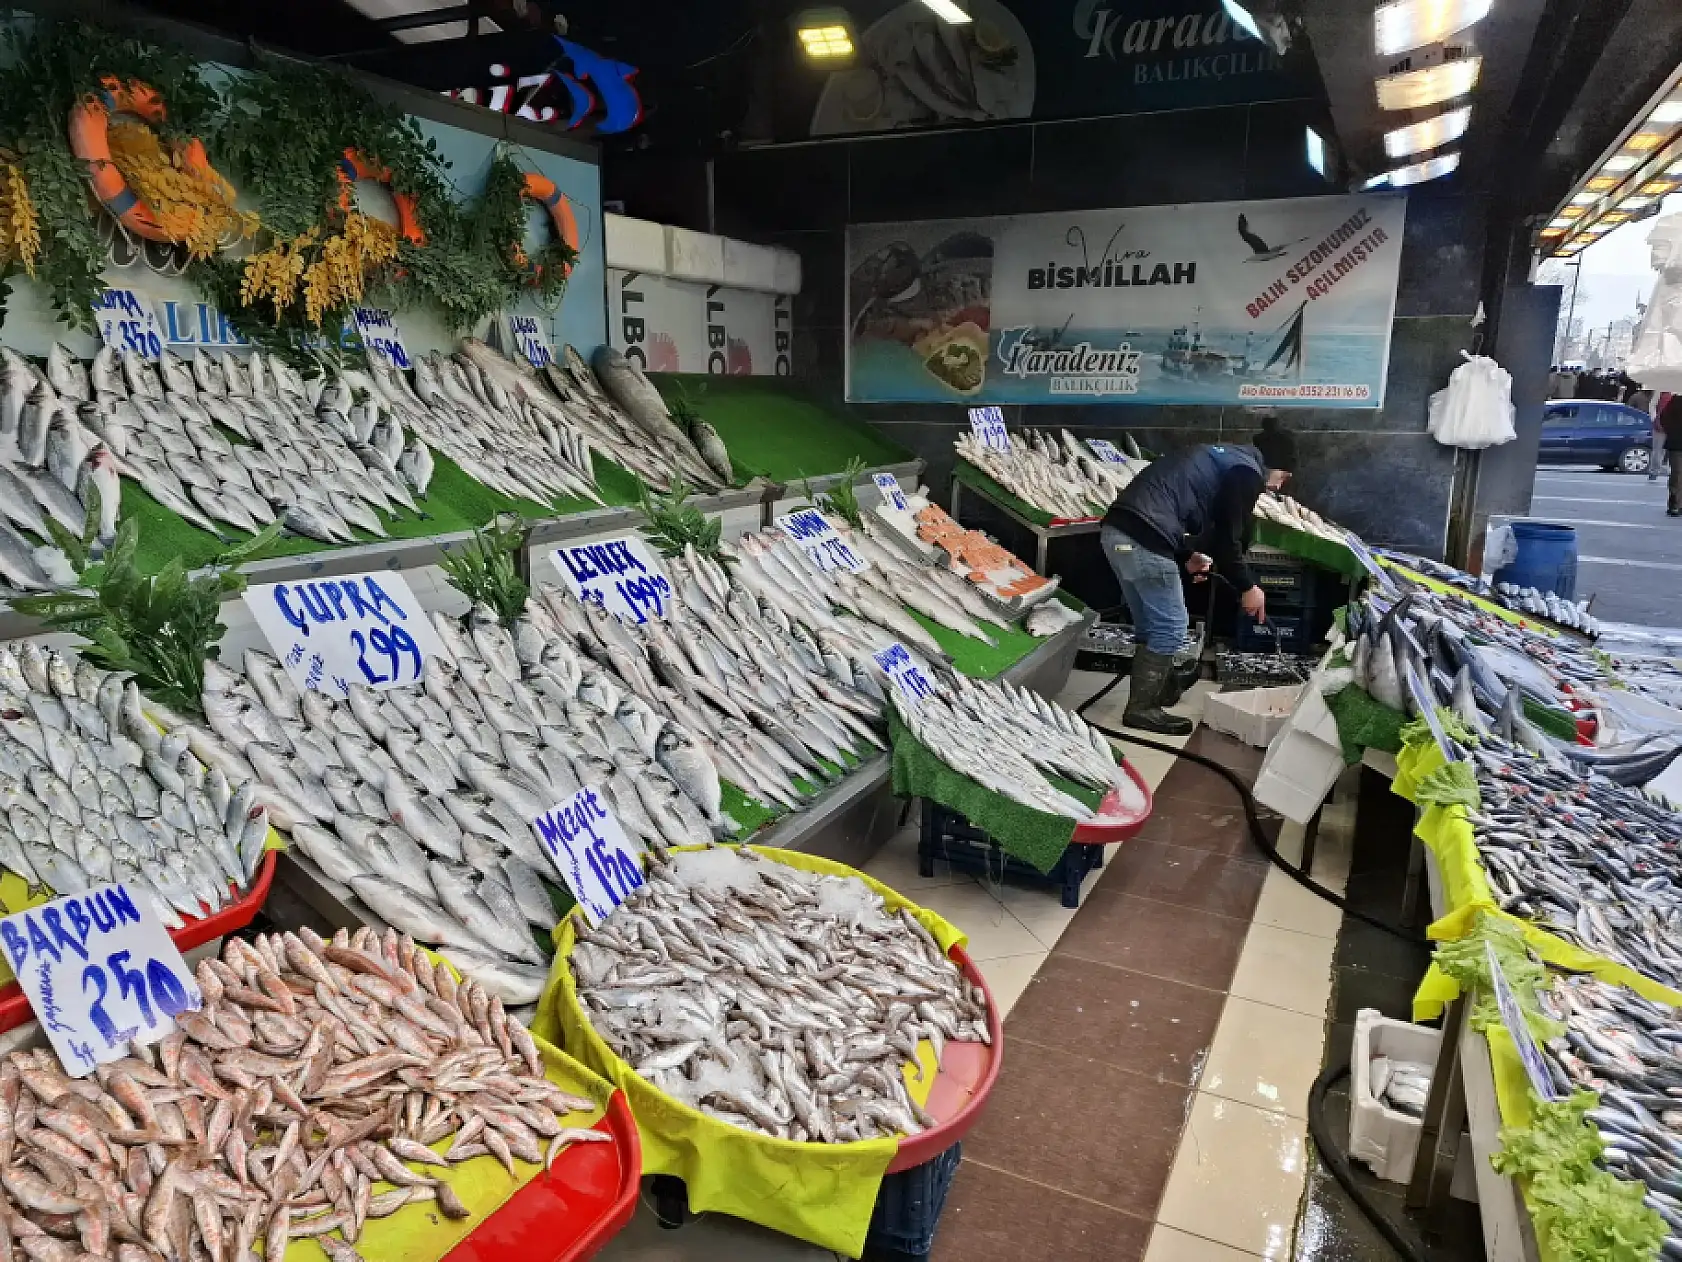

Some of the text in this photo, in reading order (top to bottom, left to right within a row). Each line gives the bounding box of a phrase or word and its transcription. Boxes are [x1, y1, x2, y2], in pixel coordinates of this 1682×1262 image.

[1028, 261, 1197, 290] BİSMİLLAH
[1245, 207, 1372, 319] BALIK SEZONUMUZ
[1306, 226, 1390, 301] AÇILMIŞTIR
[1001, 339, 1143, 378] Karadeniz
[1052, 377, 1136, 394] BALIKÇILIK
[1298, 385, 1324, 397] 0352
[1324, 385, 1341, 397] 231
[1343, 386, 1353, 397] 16
[1355, 386, 1369, 398] 06
[557, 541, 647, 583] LEVREK
[274, 576, 408, 637] ÇUPRA
[350, 624, 423, 685] 299
[585, 838, 643, 906] 150
[1, 884, 141, 977] BARBUN
[82, 949, 191, 1049] 250
